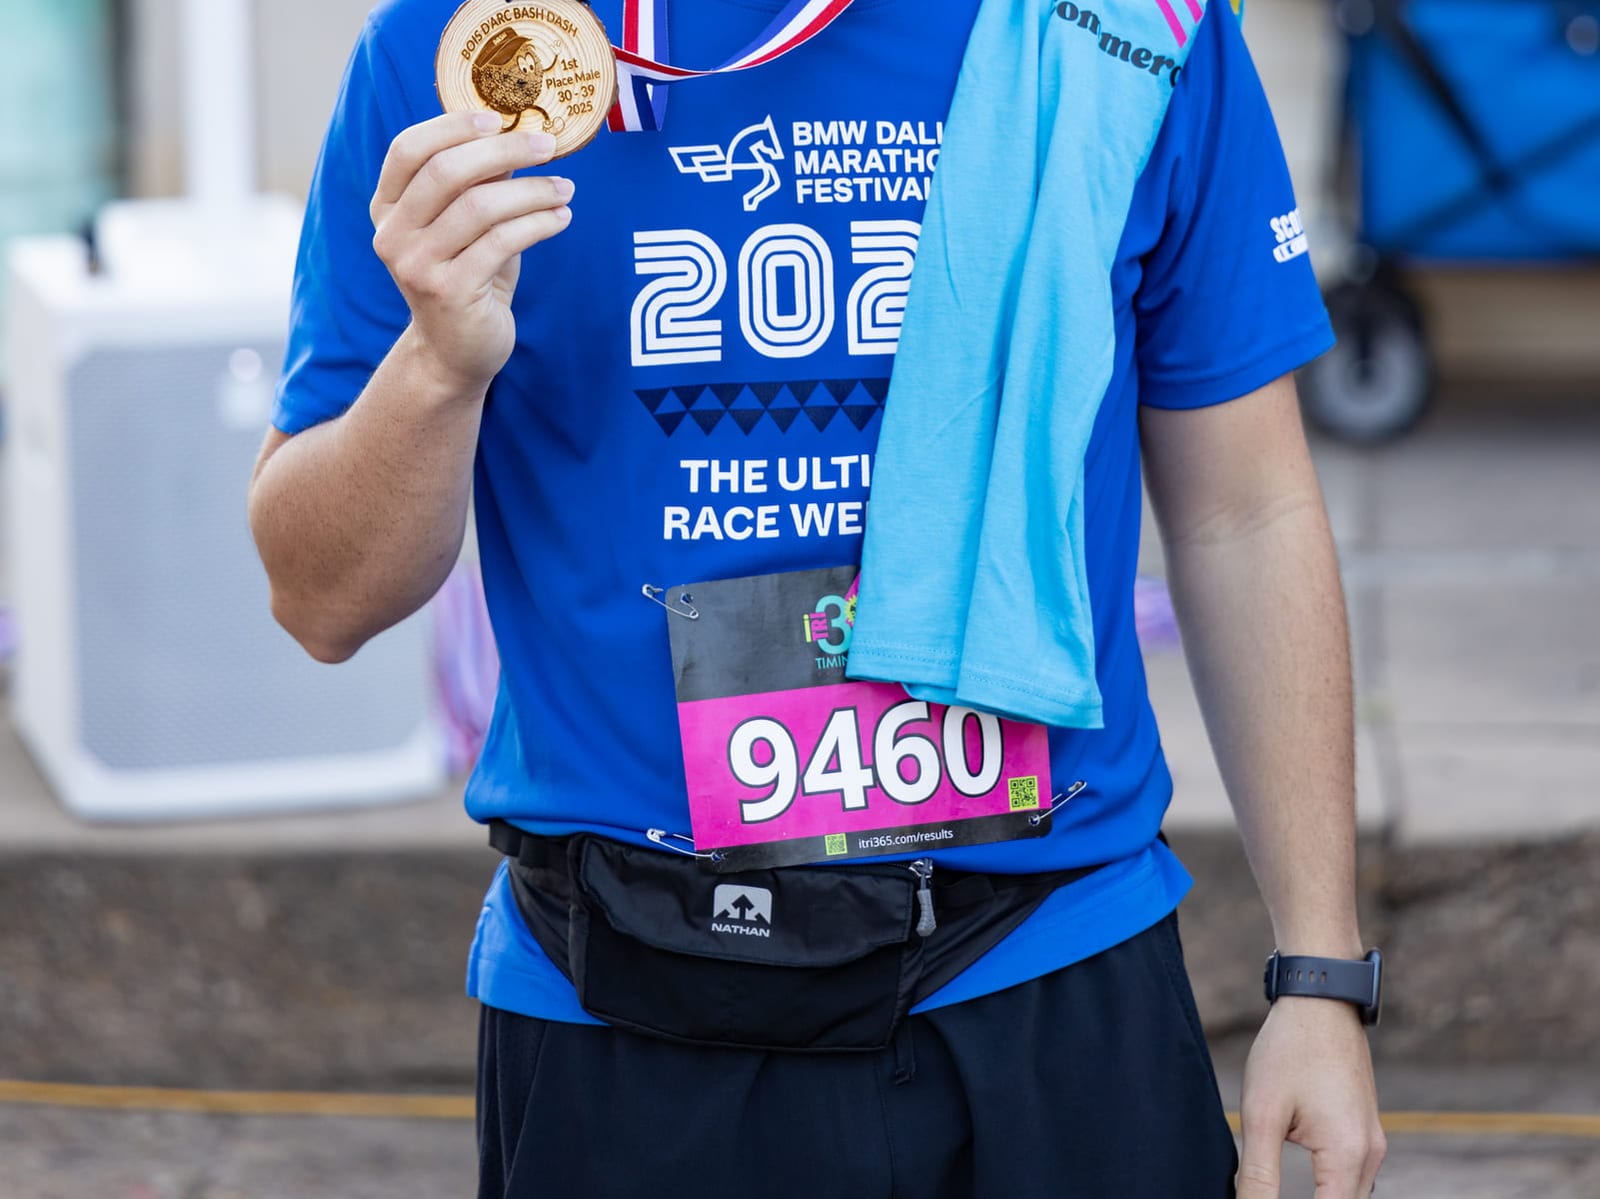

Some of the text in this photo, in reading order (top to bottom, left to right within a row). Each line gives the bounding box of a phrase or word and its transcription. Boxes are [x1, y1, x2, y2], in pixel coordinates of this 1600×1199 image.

[461, 7, 578, 61] BOIS D'ARC BASH DASH
[560, 57, 578, 71] 1st
[546, 69, 601, 90] Place Male
[557, 90, 573, 103] 30
[582, 85, 595, 97] 39
[566, 101, 593, 117] 2025
[792, 120, 867, 146] BMW
[680, 454, 871, 493] THE ULTI
[664, 501, 870, 540] RACE WE
[727, 700, 1004, 824] 9460
[858, 828, 954, 849] itri365.com/results
[711, 922, 771, 938] NATHAN
